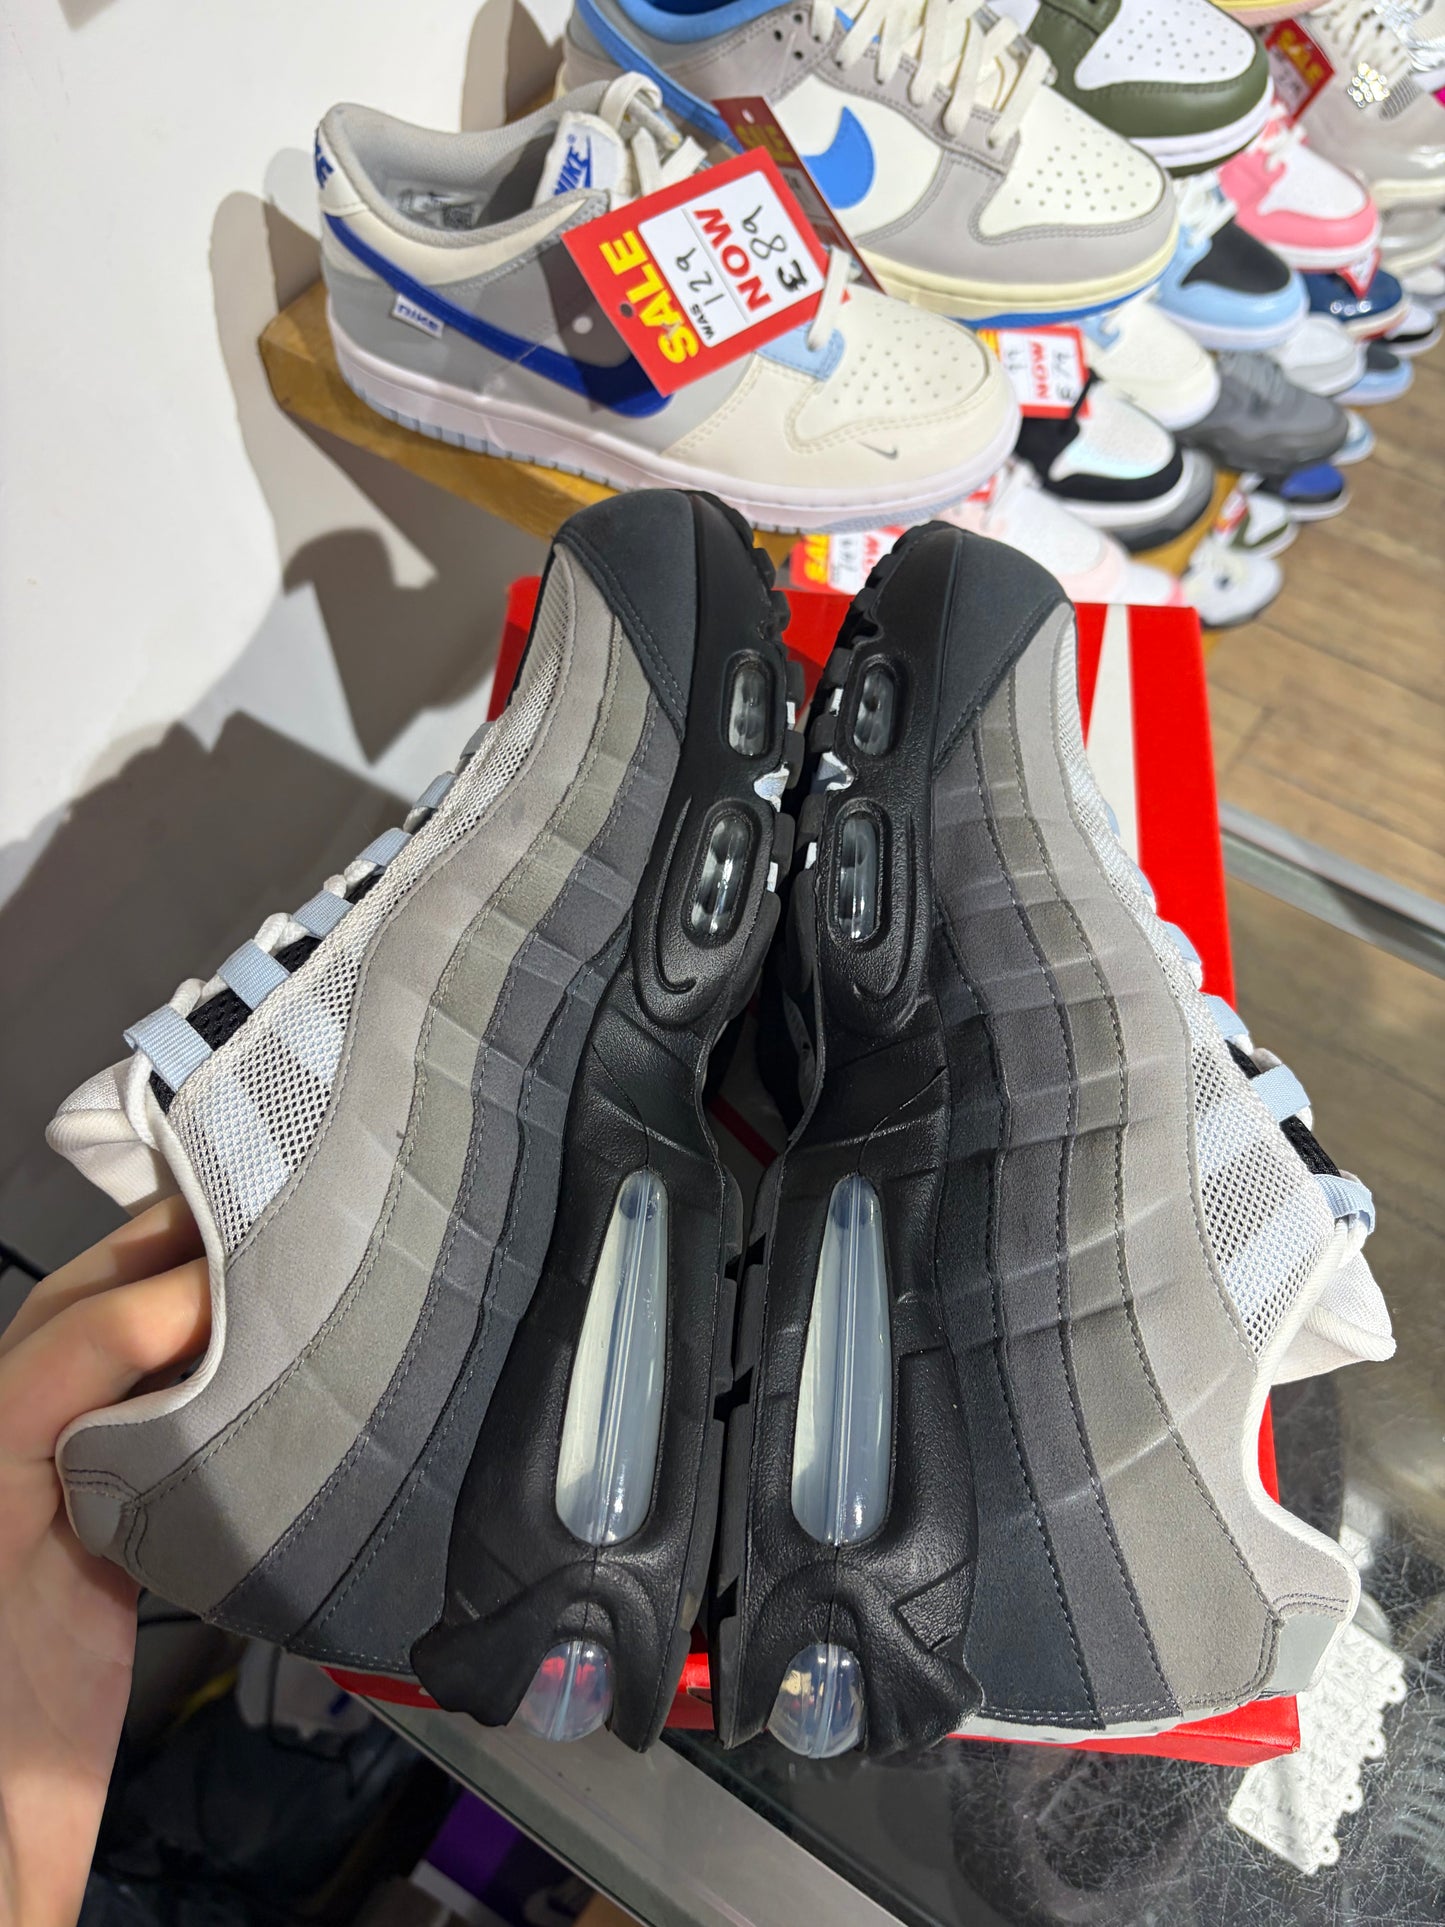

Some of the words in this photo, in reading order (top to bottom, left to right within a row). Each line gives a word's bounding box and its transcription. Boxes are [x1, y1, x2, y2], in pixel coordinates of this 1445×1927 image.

[676, 247, 725, 307] 129
[692, 207, 773, 313] NOW
[599, 230, 699, 364] SALE
[690, 303, 716, 341] WAS
[1031, 340, 1049, 400] NOW
